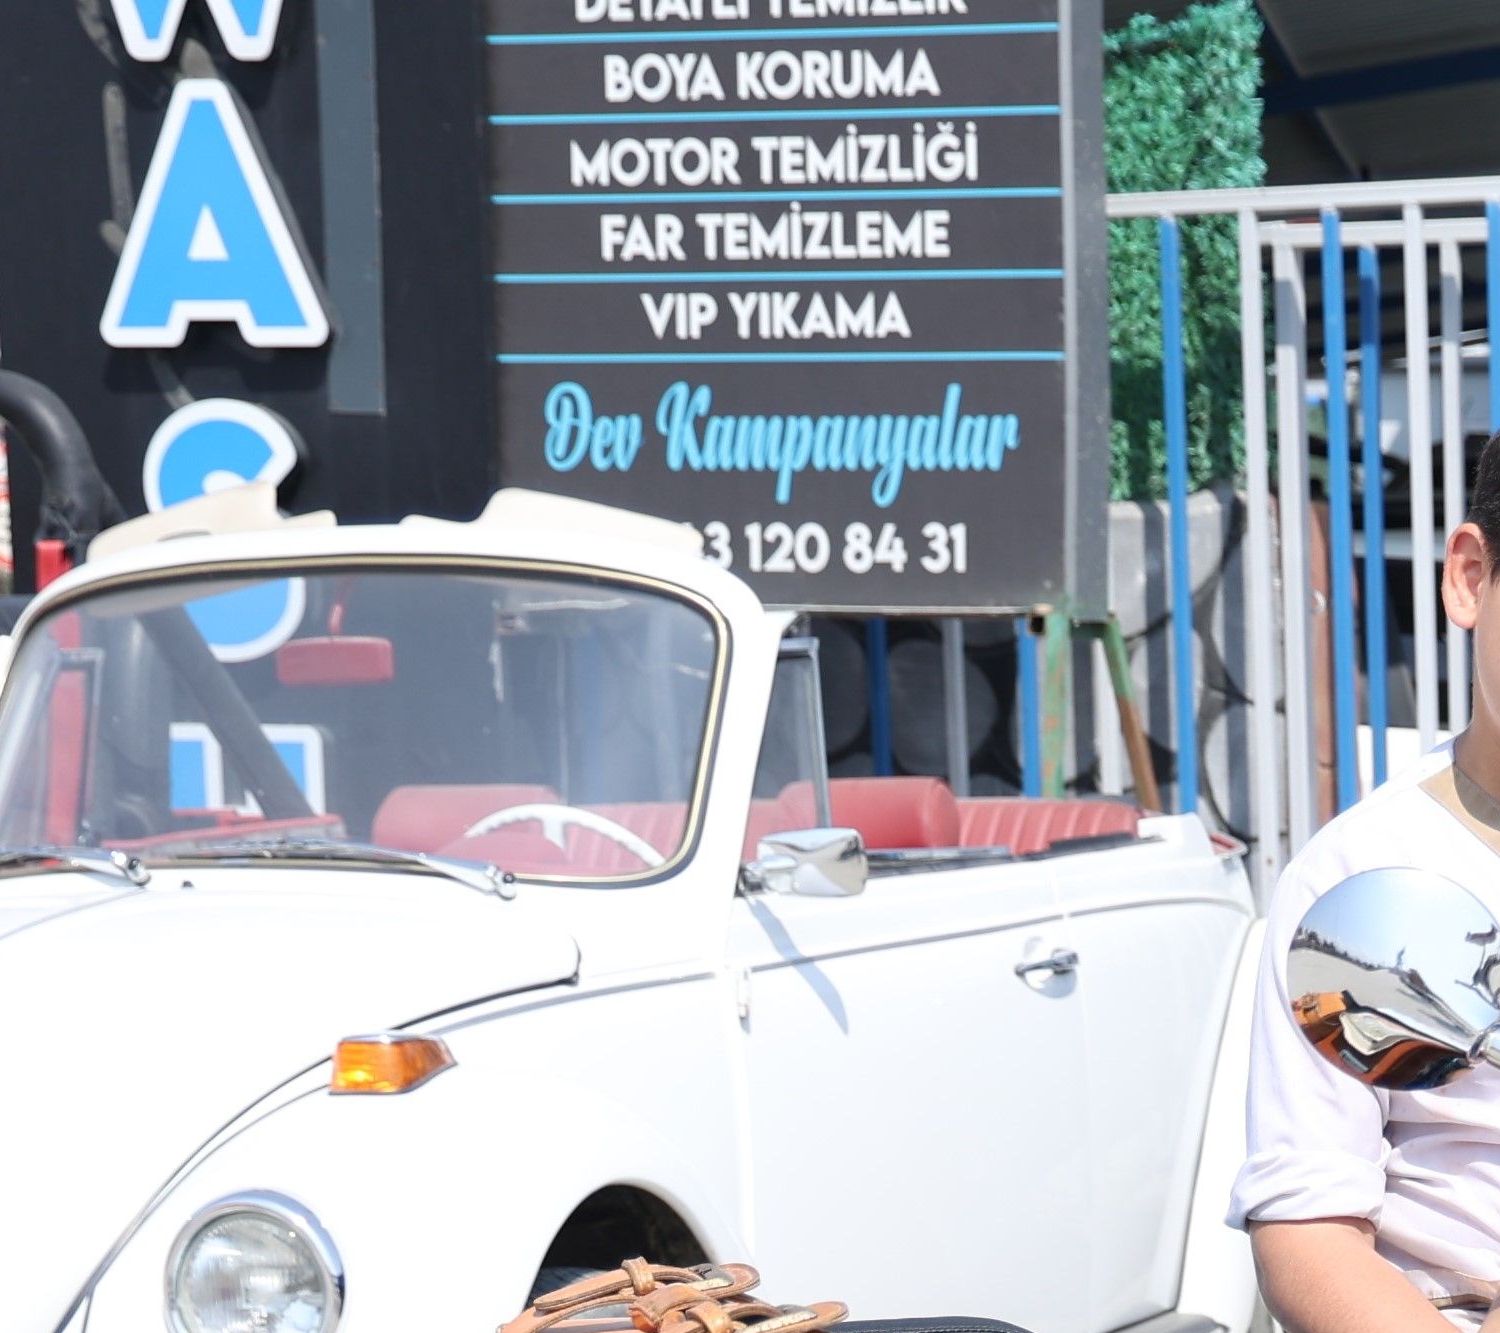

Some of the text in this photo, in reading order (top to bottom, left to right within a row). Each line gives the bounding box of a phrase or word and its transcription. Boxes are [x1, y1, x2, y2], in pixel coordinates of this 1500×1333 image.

[604, 48, 941, 102] BOYA KORUMA
[570, 121, 978, 187] MOTOR TEMİZLİĞİ
[601, 201, 950, 261] FAR TEMİZLEME
[640, 291, 911, 340] VIP YIKAMA
[544, 381, 1020, 508] Dev Kampanyalar
[744, 522, 830, 573] 120
[843, 522, 908, 573] 84
[920, 522, 967, 573] 31
